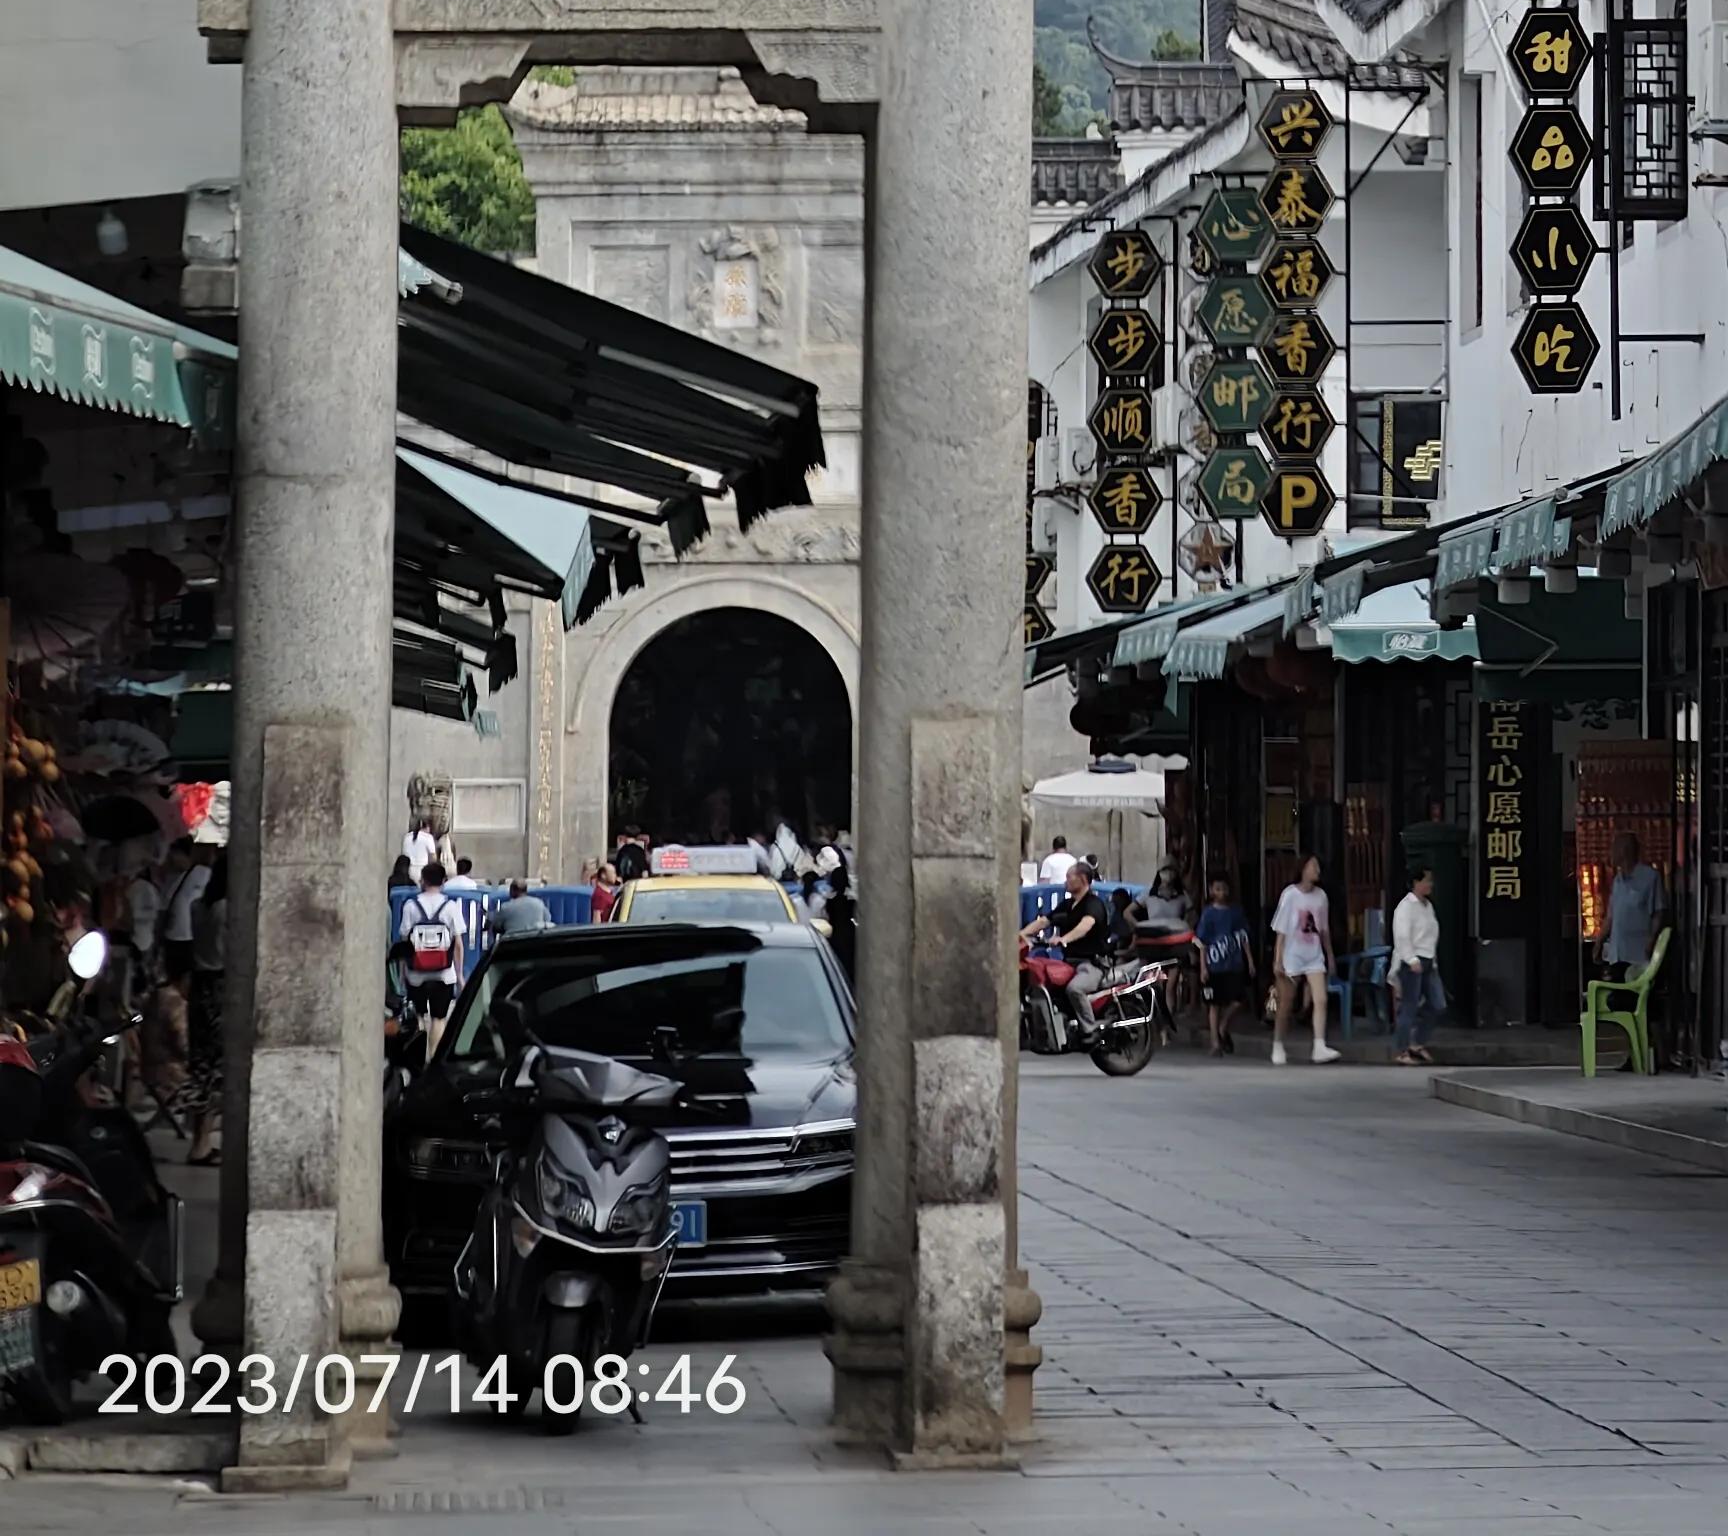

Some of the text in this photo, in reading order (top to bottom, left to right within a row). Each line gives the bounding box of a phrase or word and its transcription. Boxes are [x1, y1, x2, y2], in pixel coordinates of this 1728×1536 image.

[1210, 206, 1261, 504] 心愿邮局
[1268, 100, 1322, 448] 兴泰福香行
[1527, 30, 1580, 372] 甜品小吃
[1100, 240, 1150, 604] 步步顺香行
[1280, 474, 1317, 526] P
